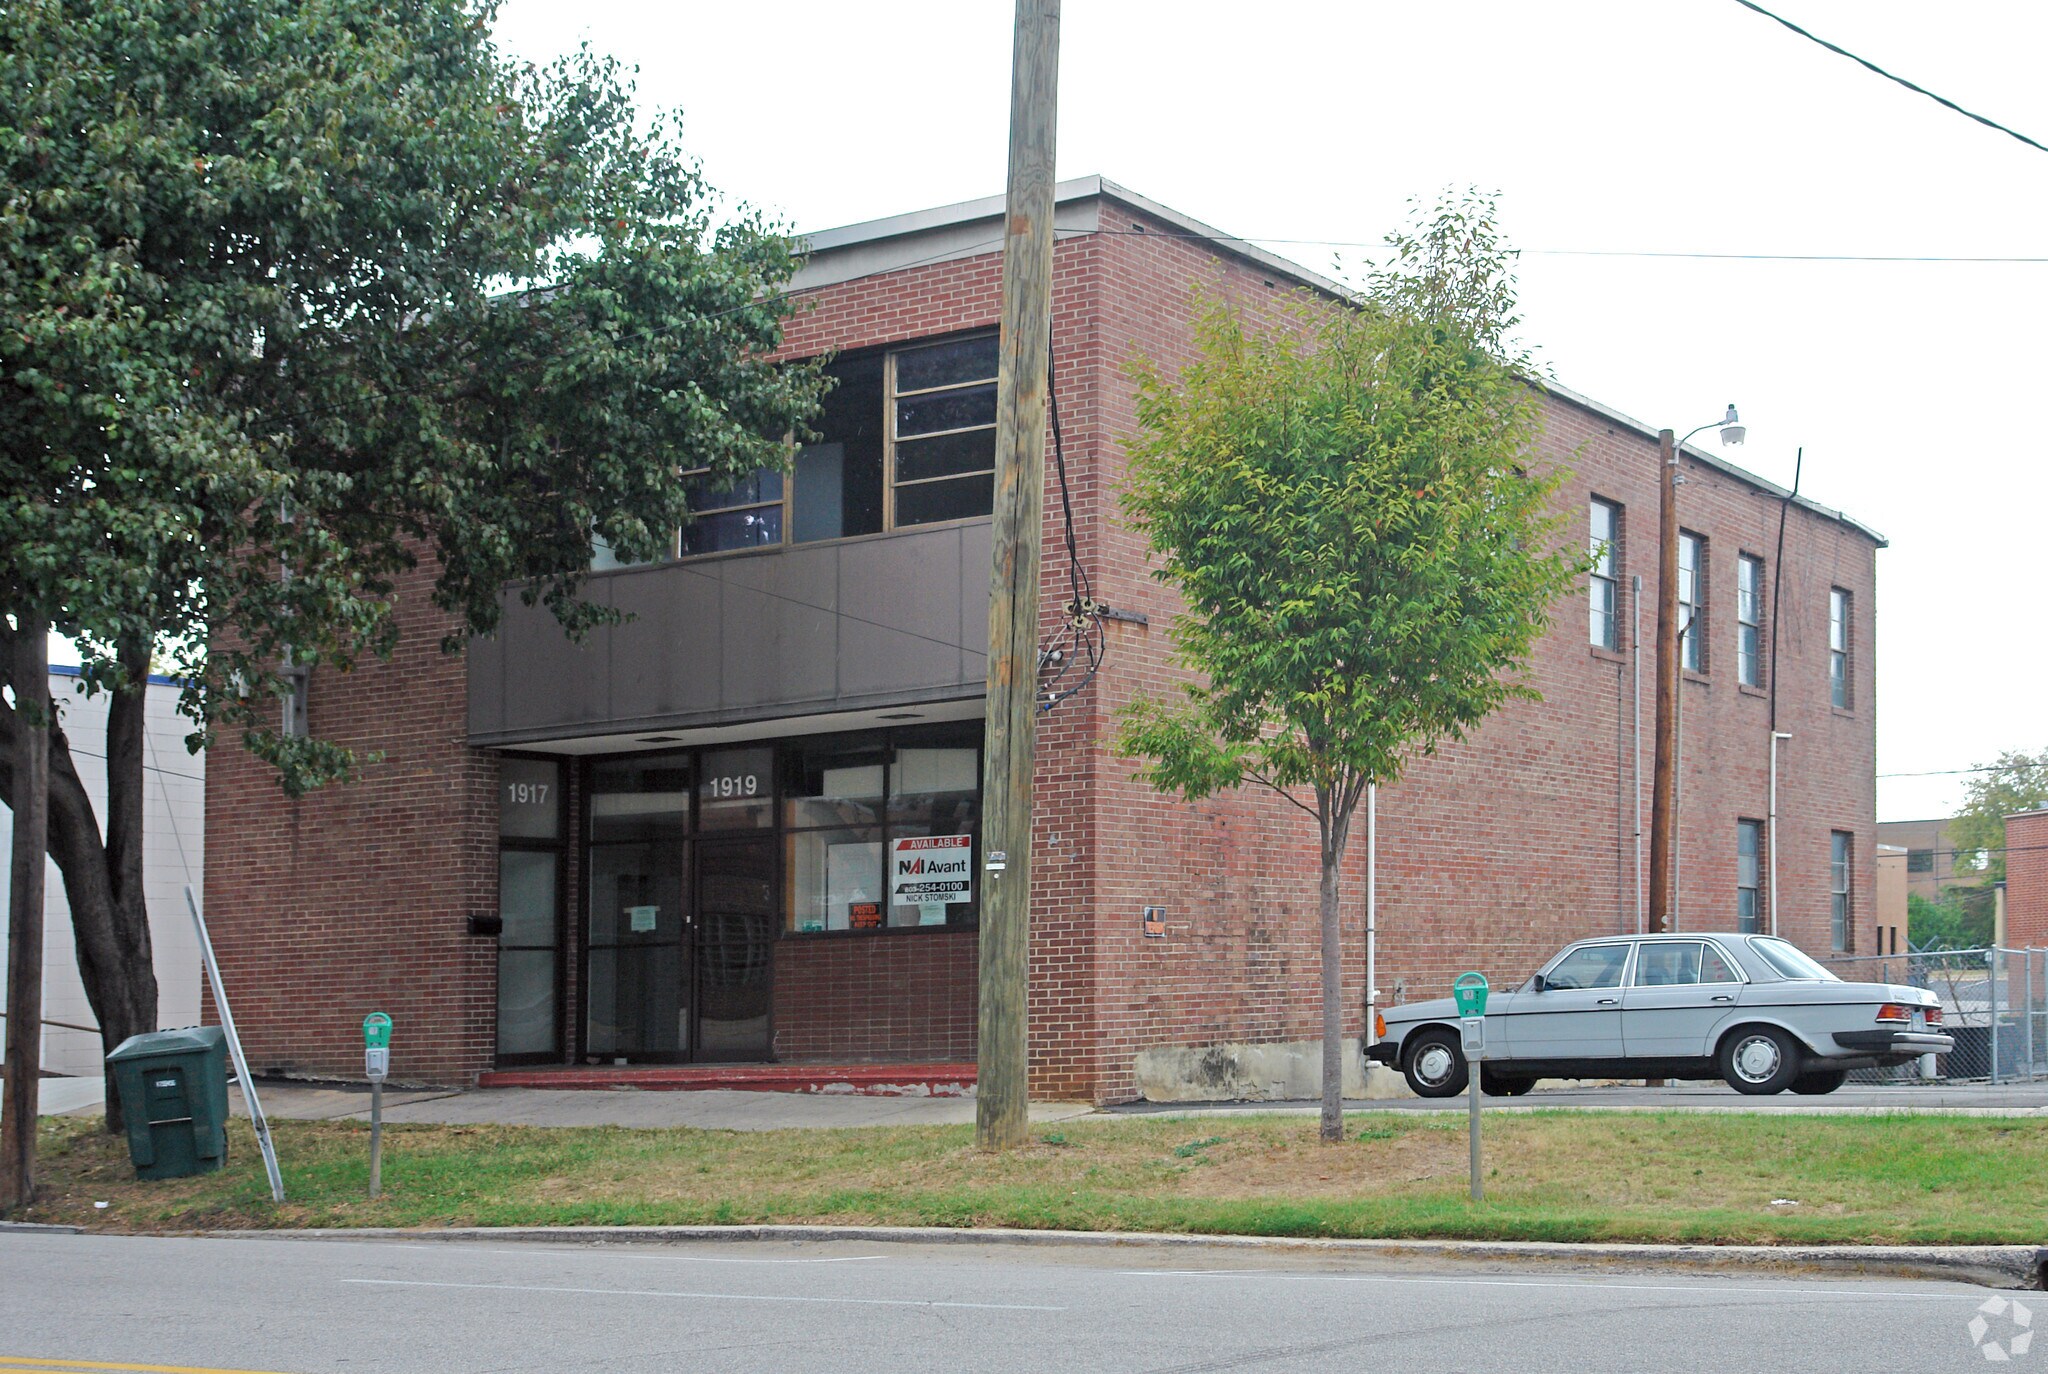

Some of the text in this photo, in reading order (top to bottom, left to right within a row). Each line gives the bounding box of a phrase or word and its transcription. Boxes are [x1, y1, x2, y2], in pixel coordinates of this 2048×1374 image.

[508, 783, 548, 804] 1917
[710, 775, 757, 797] 1919
[910, 837, 963, 850] AVAILABLE
[899, 857, 966, 875] NAI Avant
[924, 893, 956, 901] STOMSKI
